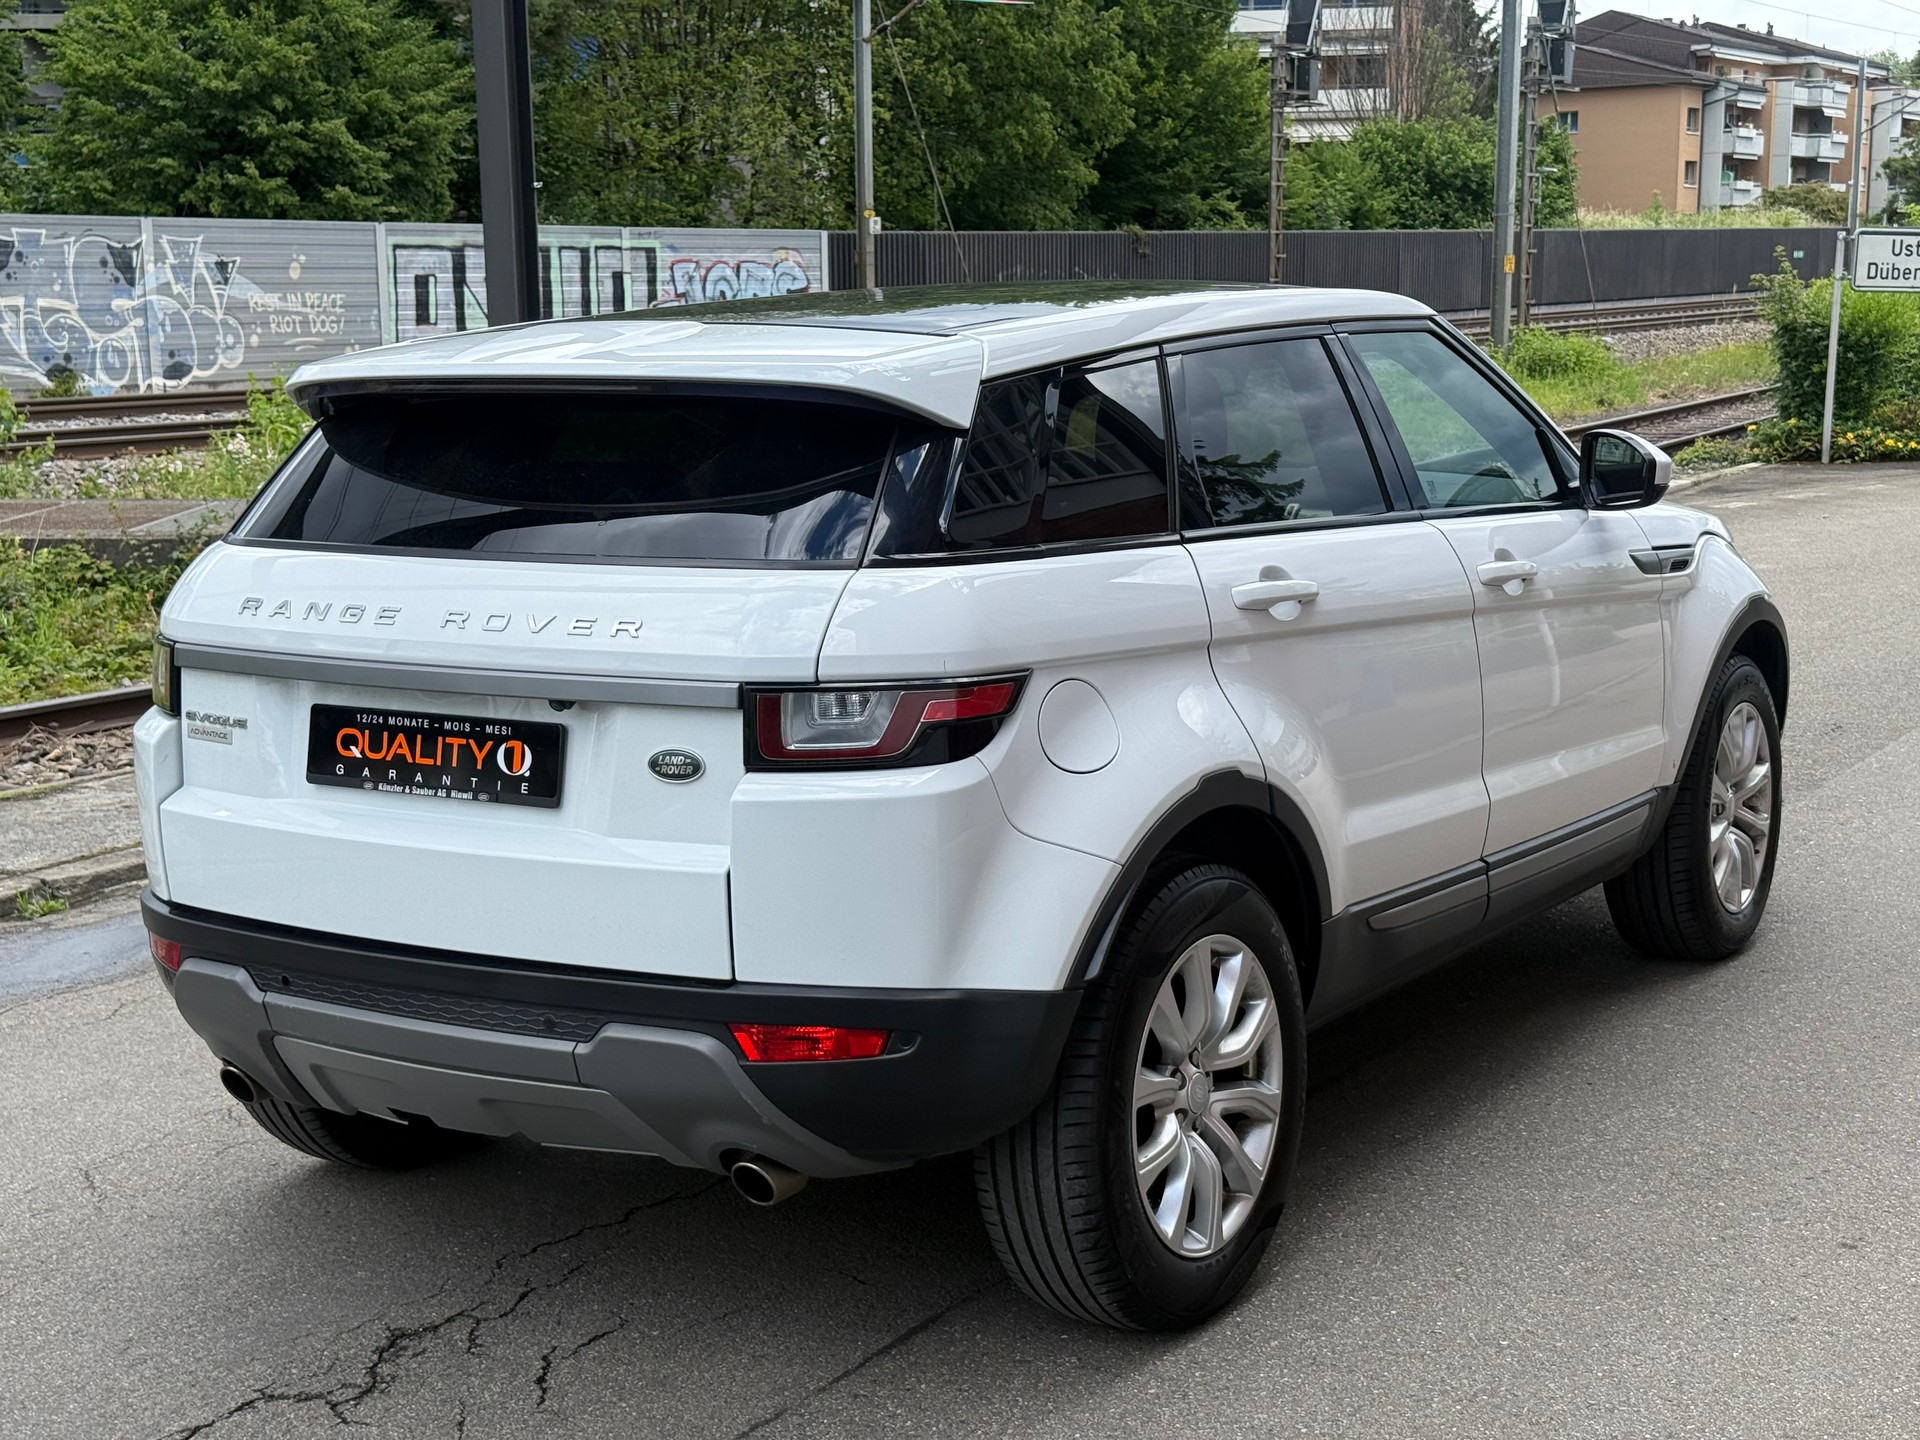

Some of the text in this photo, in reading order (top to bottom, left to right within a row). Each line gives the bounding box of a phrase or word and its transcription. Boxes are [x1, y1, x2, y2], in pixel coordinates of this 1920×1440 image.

[247, 291, 346, 313] REST IN PEACE
[269, 314, 345, 335] RIOT DOG!
[238, 596, 644, 639] RANGE ROVER
[185, 710, 248, 730] EVOQUE
[356, 713, 383, 724] 12/24
[388, 716, 430, 729] MONATE
[443, 721, 471, 732] MOIS
[485, 724, 512, 736] MESI
[190, 727, 229, 740] ADVANTAGE
[336, 727, 494, 770] QUALITY
[658, 755, 685, 765] LAND
[660, 765, 694, 775] ROVER
[335, 763, 529, 794] GARANTIE
[378, 782, 473, 800] Künzler & Sauber AG Hinwil
